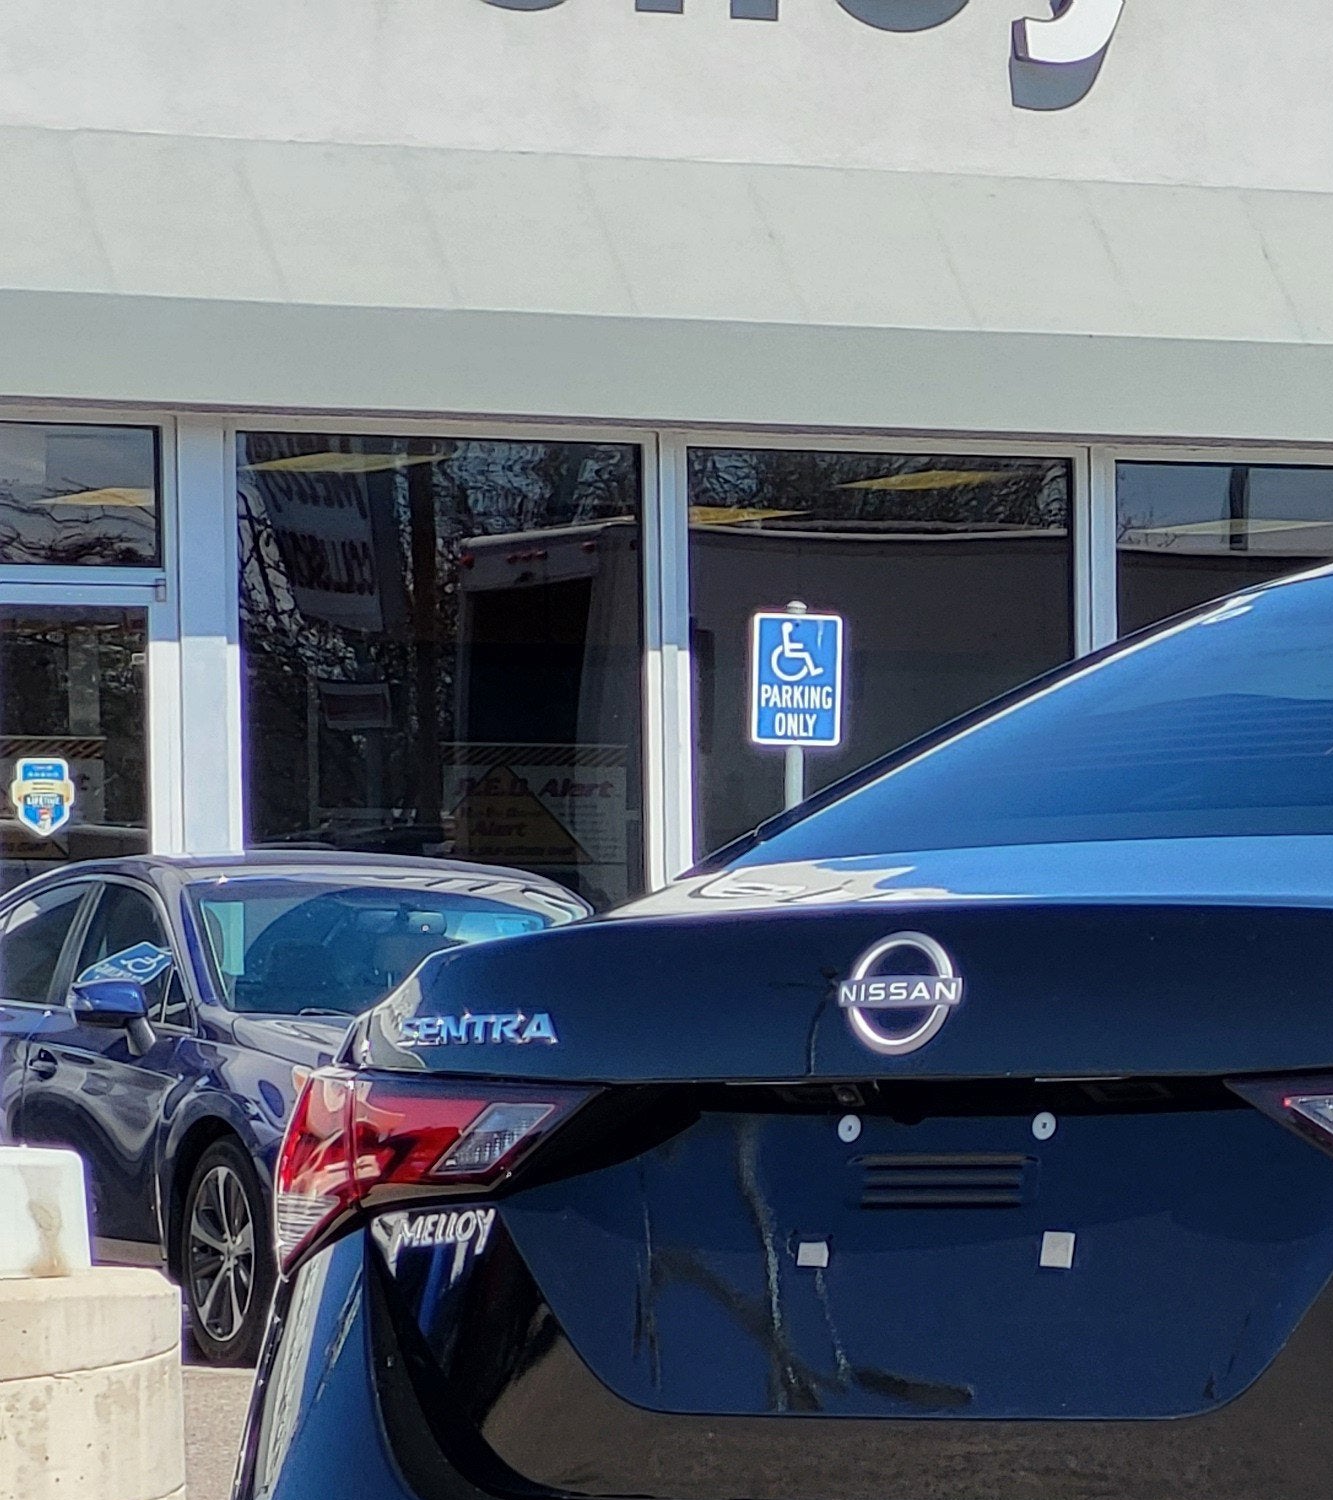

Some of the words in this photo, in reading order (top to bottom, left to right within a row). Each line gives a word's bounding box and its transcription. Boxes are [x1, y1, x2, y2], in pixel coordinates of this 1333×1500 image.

[761, 684, 833, 709] PARKING
[774, 712, 817, 737] ONLY
[841, 981, 957, 1002] NISSAN
[397, 1010, 559, 1046] SENTRA
